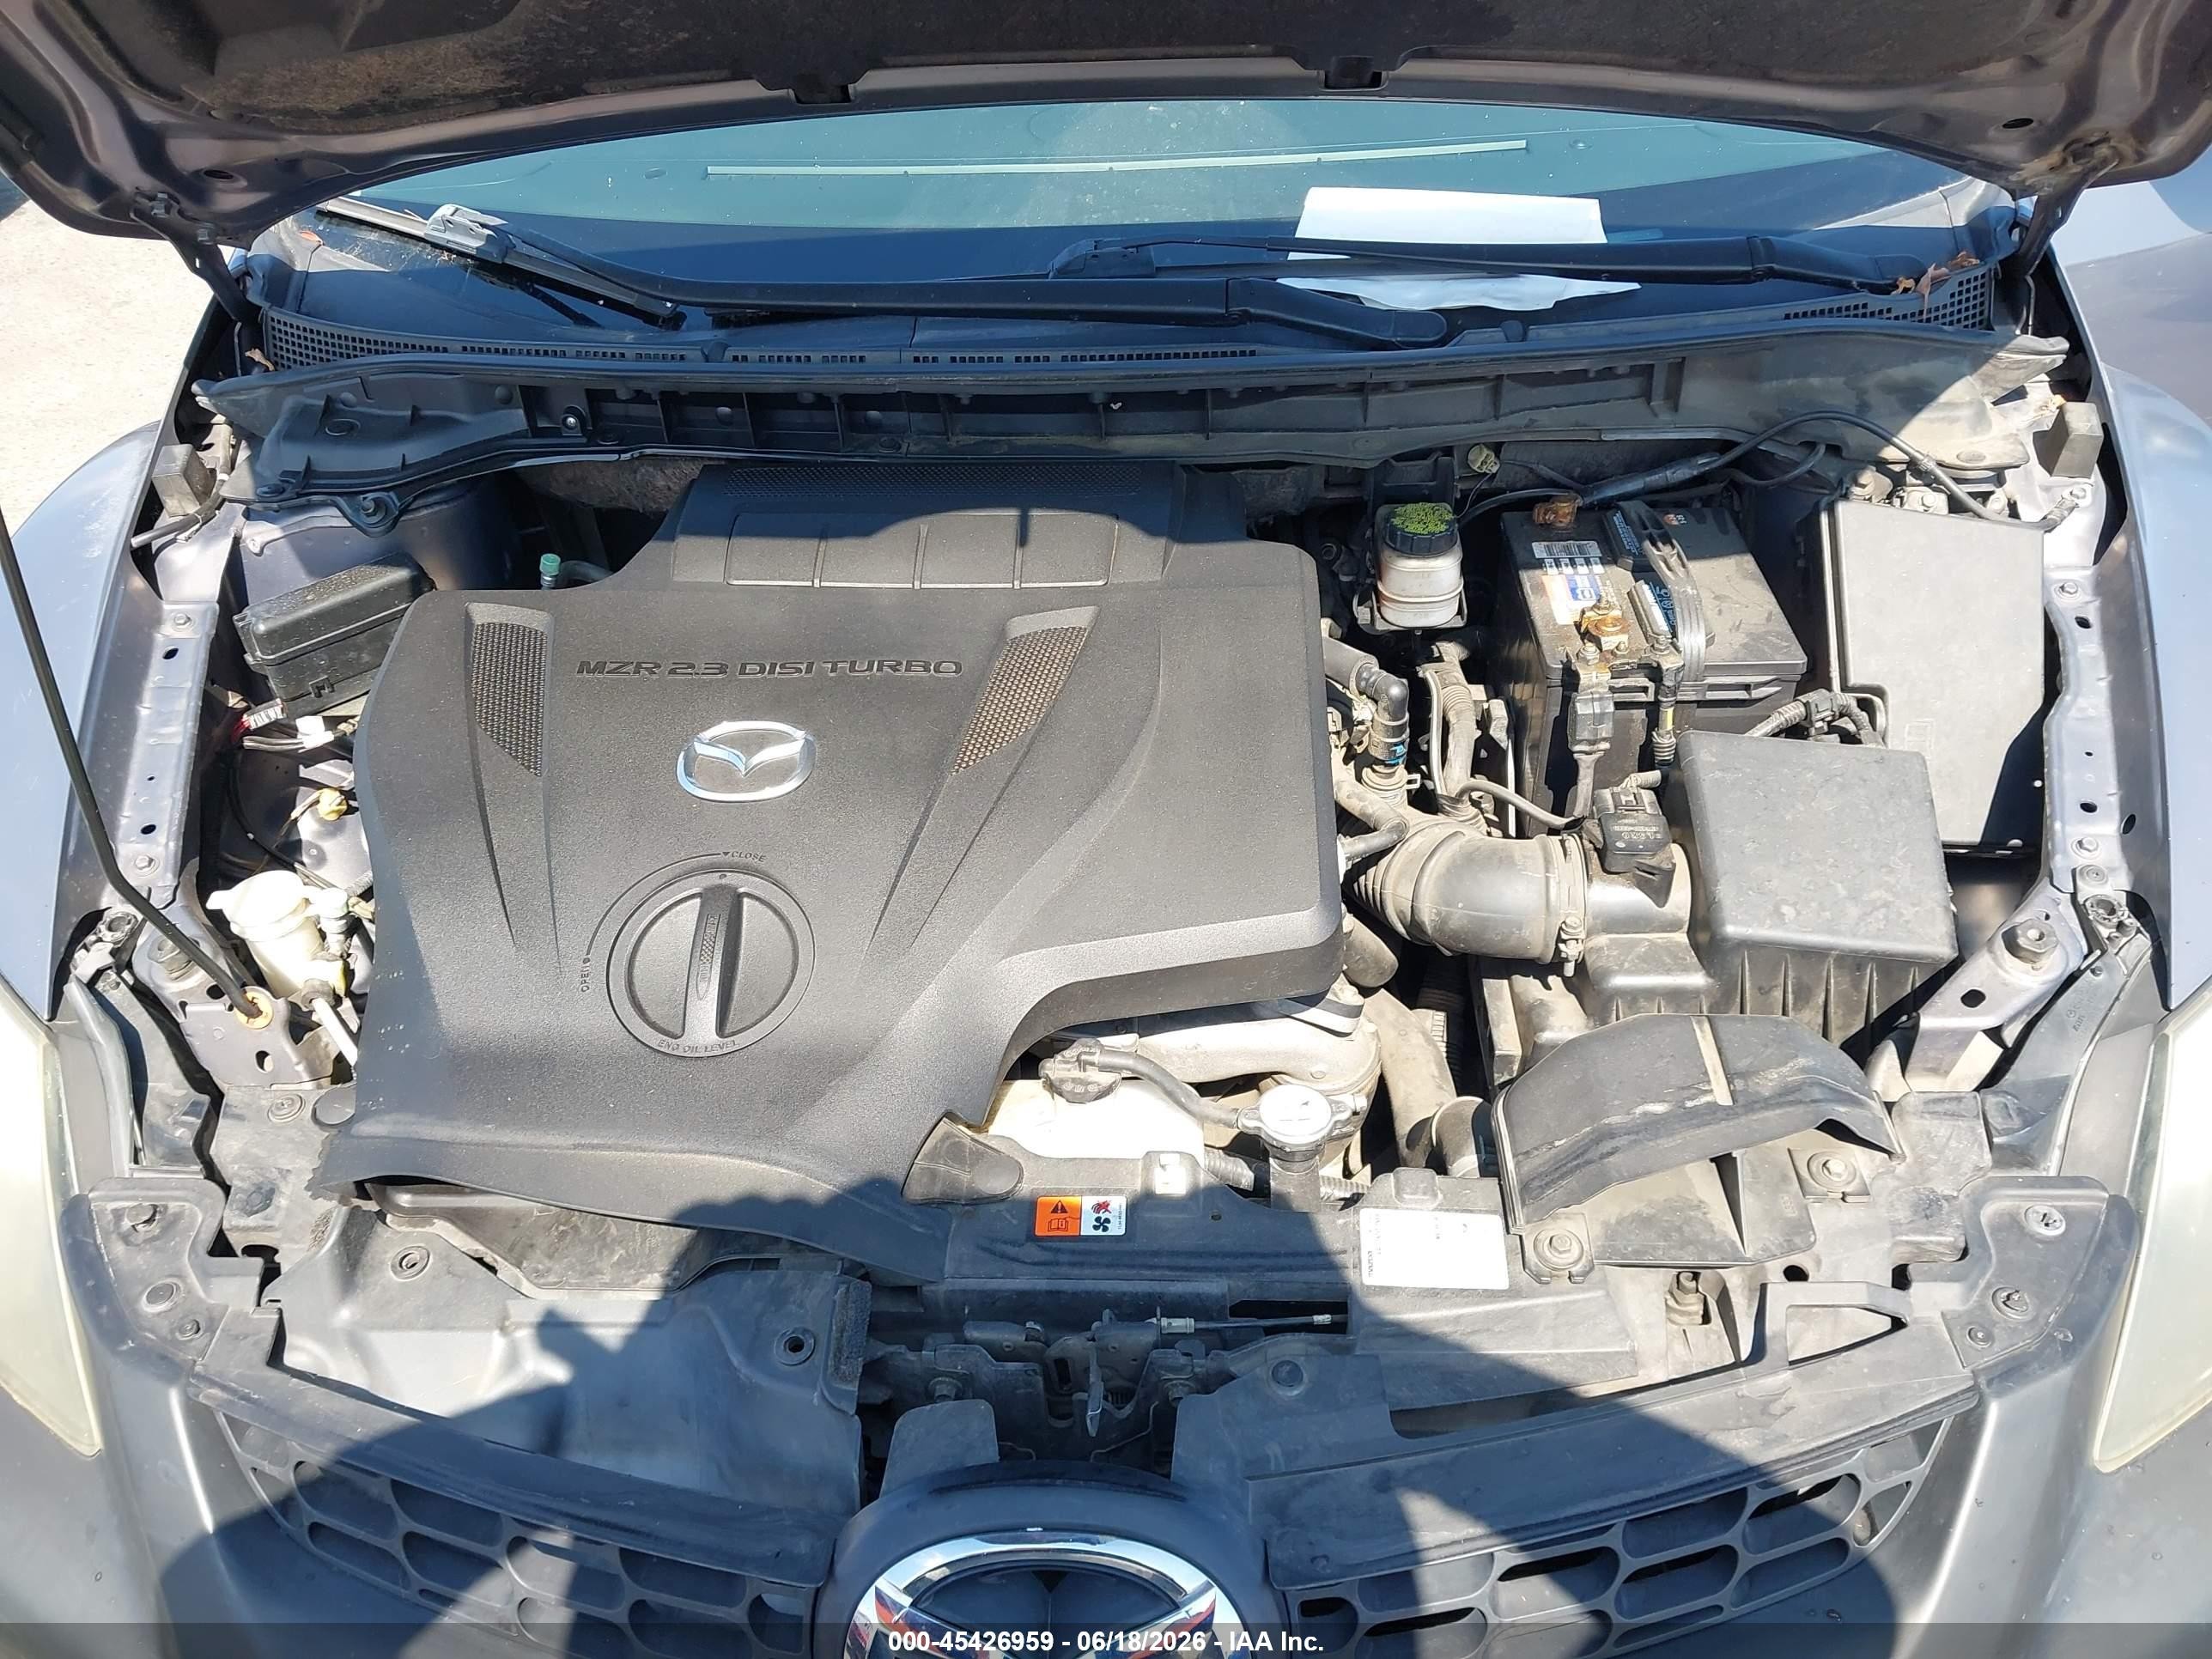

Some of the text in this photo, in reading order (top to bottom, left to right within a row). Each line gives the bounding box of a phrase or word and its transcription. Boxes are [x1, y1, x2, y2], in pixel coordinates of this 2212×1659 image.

[575, 659, 963, 678] MZR 2.3 DISI TURBO
[731, 850, 767, 863] CLOSE
[580, 964, 591, 993] OPEN
[683, 1042, 703, 1054] OIL
[704, 1039, 740, 1053] LEVEL
